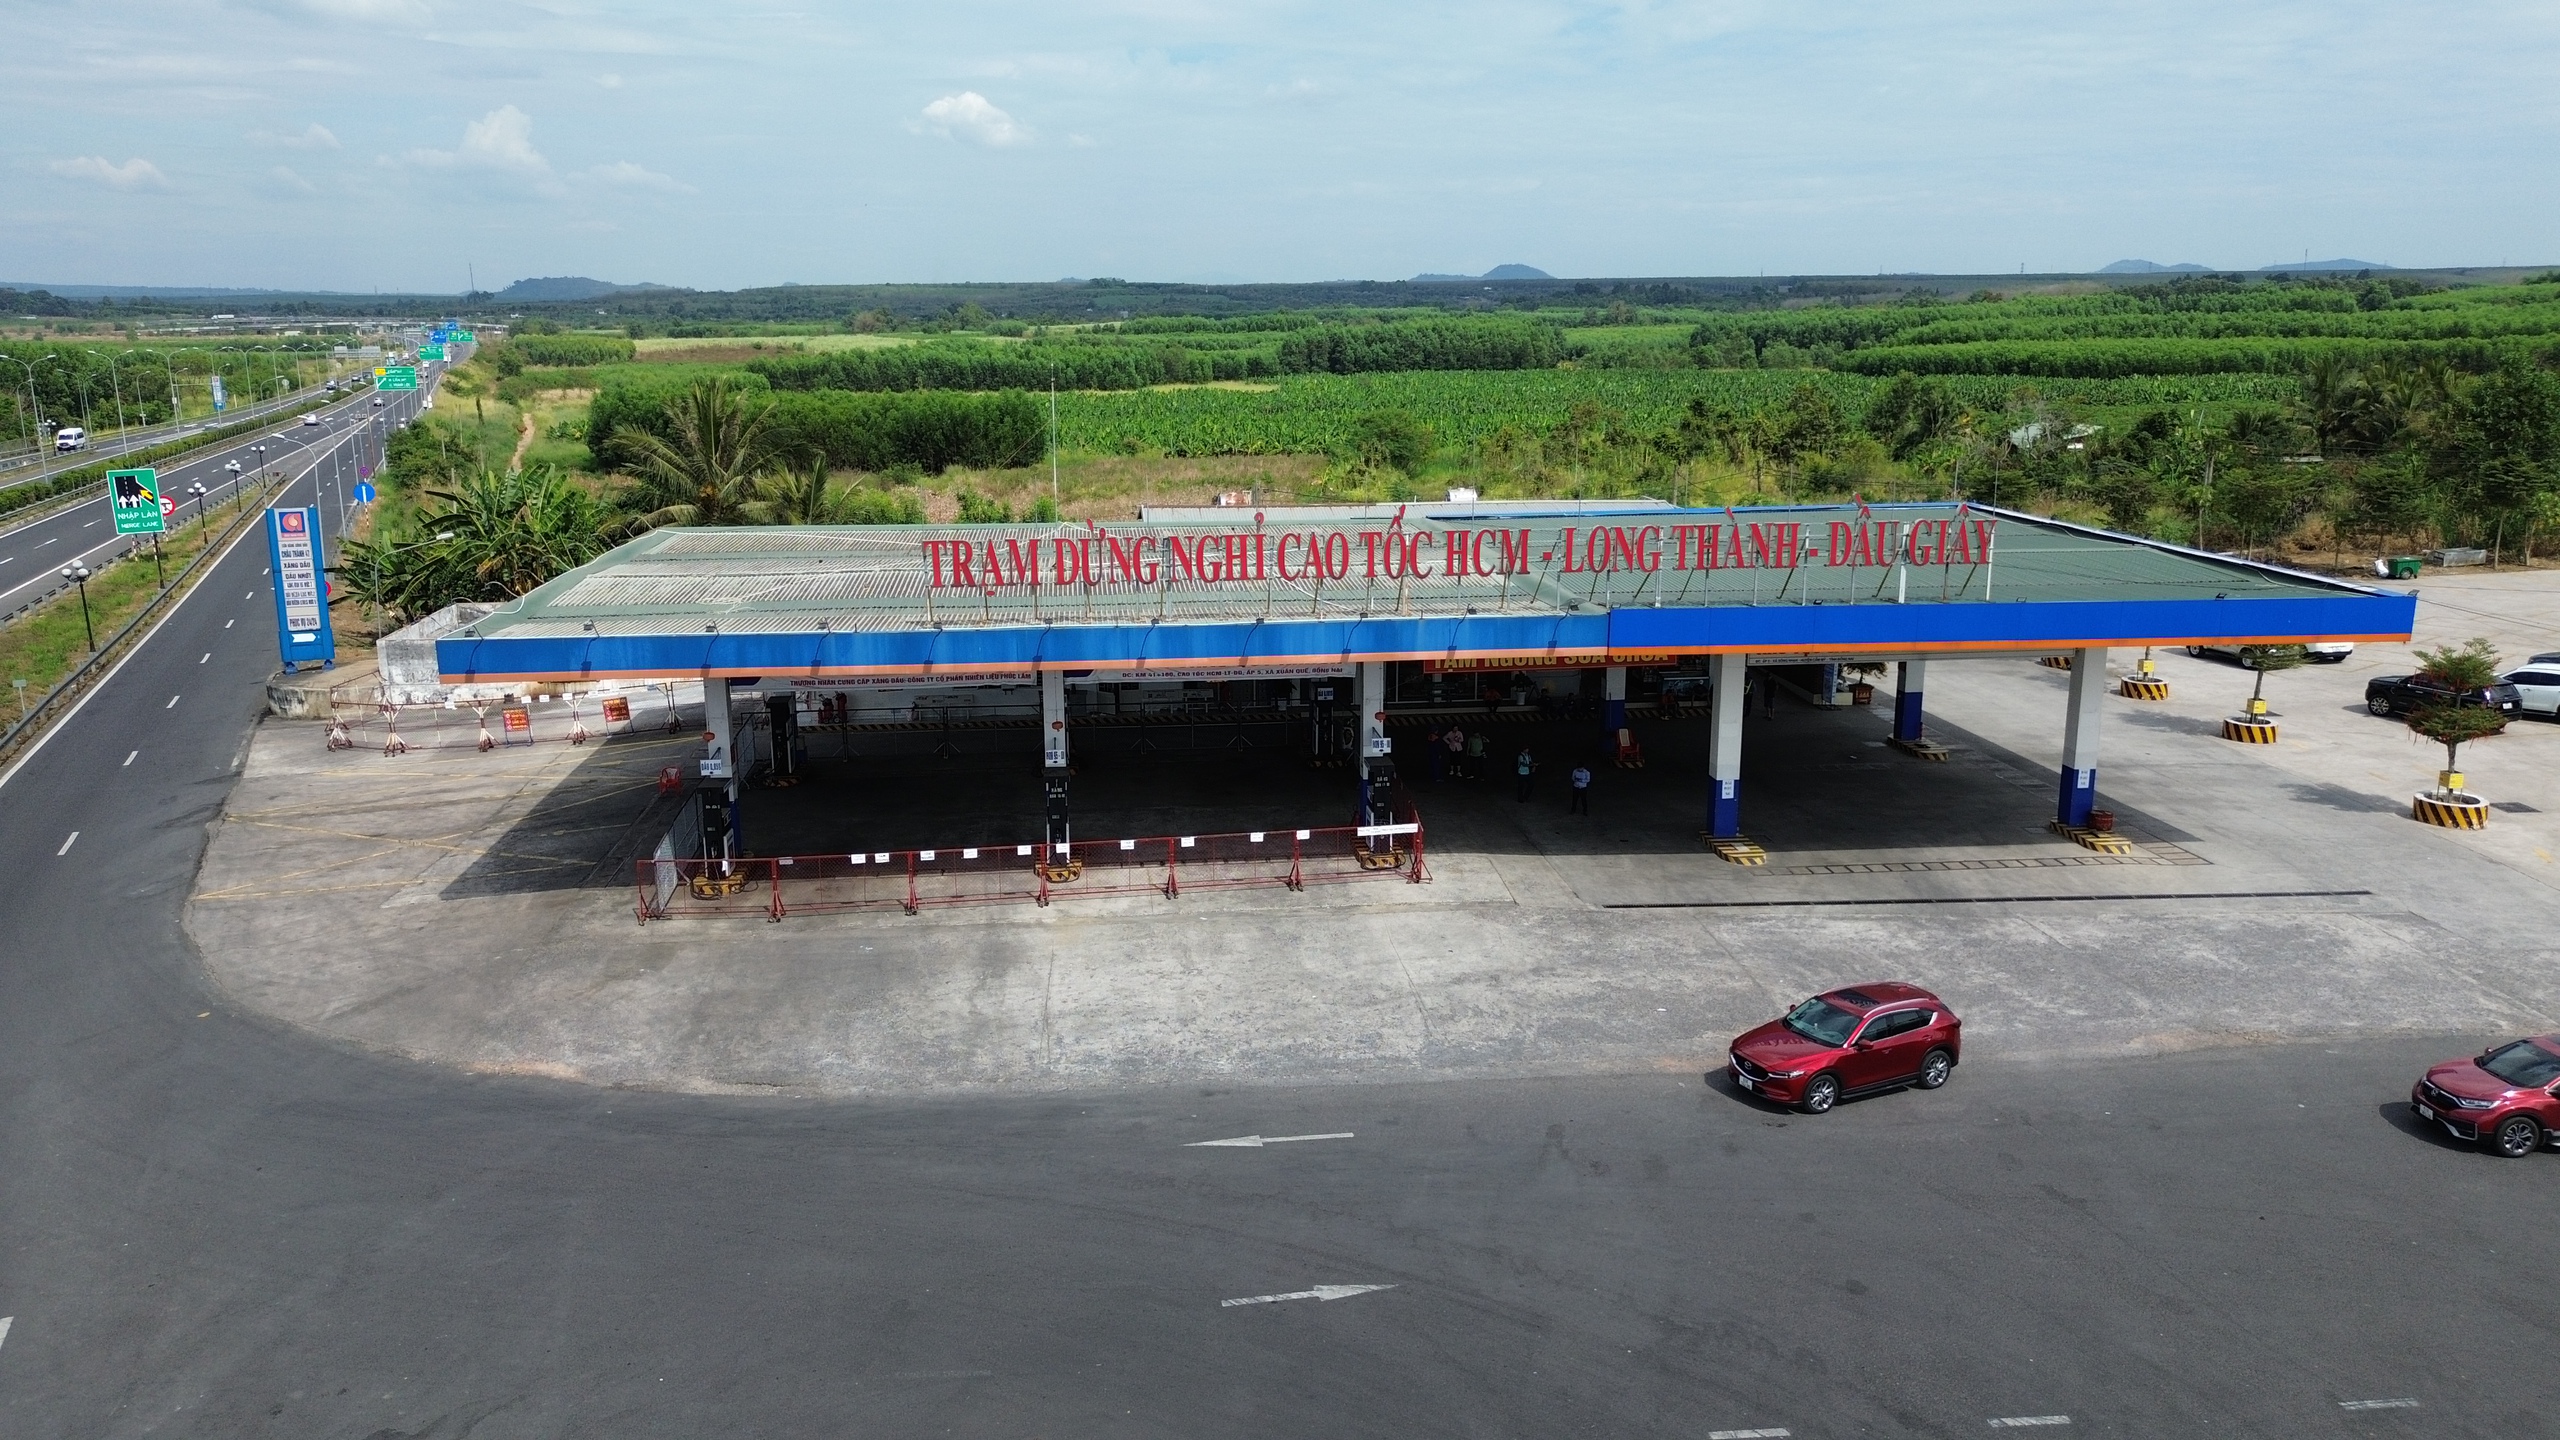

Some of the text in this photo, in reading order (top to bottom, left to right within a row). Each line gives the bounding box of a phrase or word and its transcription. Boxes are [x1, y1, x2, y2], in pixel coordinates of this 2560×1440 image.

[922, 538, 1042, 597] TRẠM
[1053, 518, 1160, 587] DỪNG
[1169, 511, 1267, 583] NGHỈ
[1276, 531, 1350, 580] CAO
[1359, 504, 1434, 579] TỐC
[1445, 529, 1532, 577] HCM
[1560, 525, 1663, 574] LONG
[1670, 506, 1802, 571] THÀNH
[1828, 492, 1900, 568] DẦU
[1908, 501, 1998, 567] GIÂY
